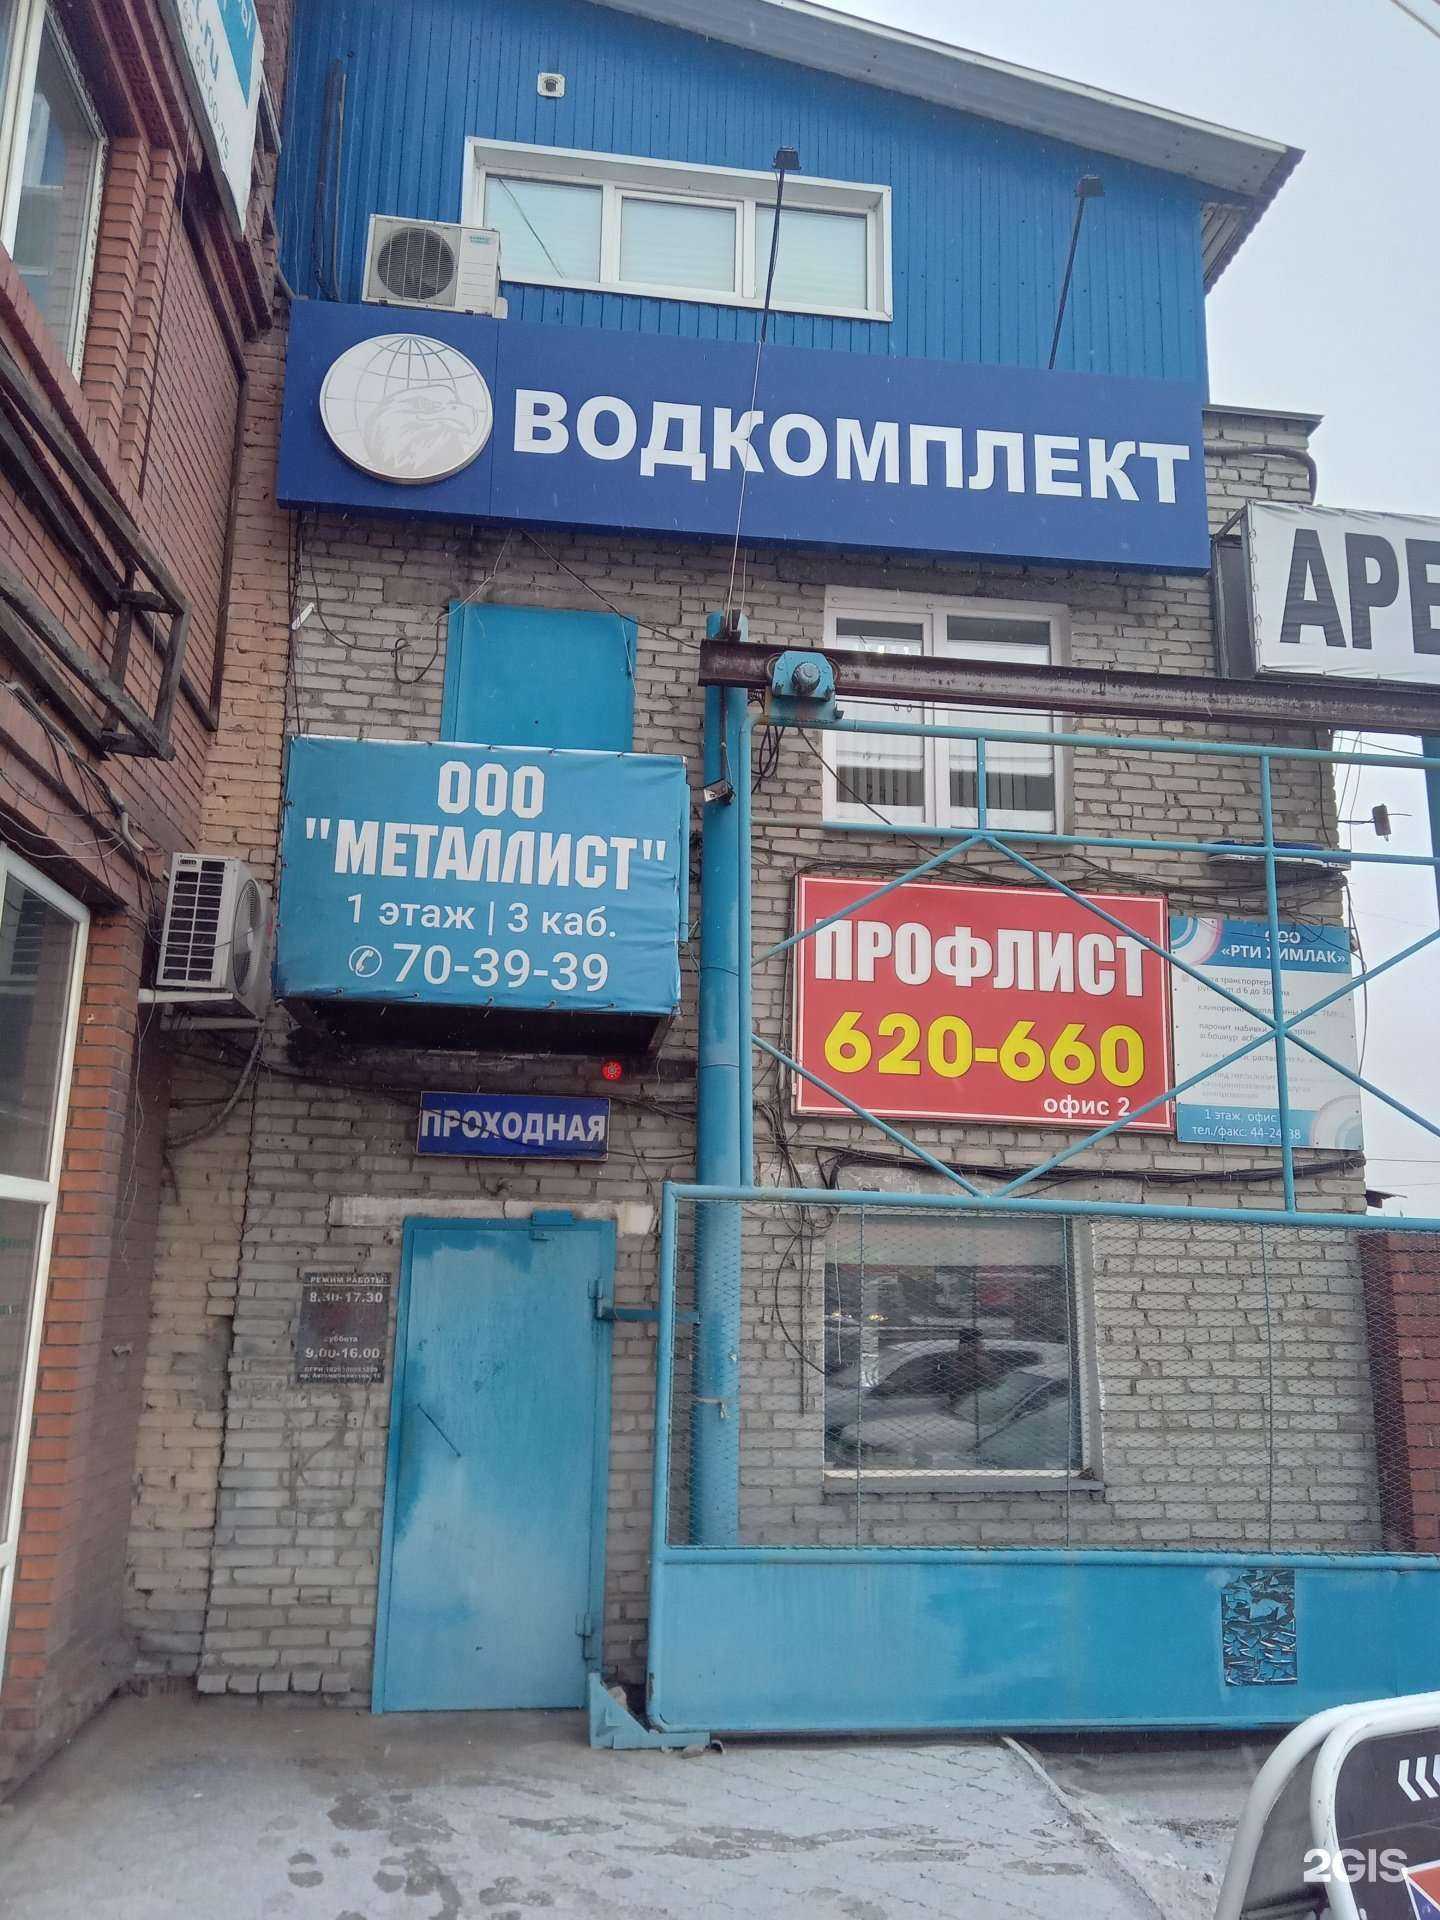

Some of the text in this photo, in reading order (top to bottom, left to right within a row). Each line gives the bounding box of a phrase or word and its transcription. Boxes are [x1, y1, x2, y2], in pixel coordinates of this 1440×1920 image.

[513, 388, 1190, 504] ВОДКОМПЛЕКТ
[437, 760, 545, 819] ООО
[305, 817, 666, 890] "МЕТАЛЛИСТ"
[346, 894, 363, 924] 1
[378, 902, 476, 930] этаж
[507, 902, 528, 933] 3
[542, 905, 616, 938] каб.
[393, 943, 609, 992] 70-39-39
[815, 919, 1151, 997] ПРОФЛИСТ
[1220, 944, 1262, 959] «РТИ
[824, 1011, 1145, 1087] 620-660
[421, 1109, 606, 1146] ПРОХОДНАЯ
[1043, 1094, 1131, 1118] офис 2
[1204, 1109, 1212, 1120] 1
[1247, 1112, 1277, 1126] офис
